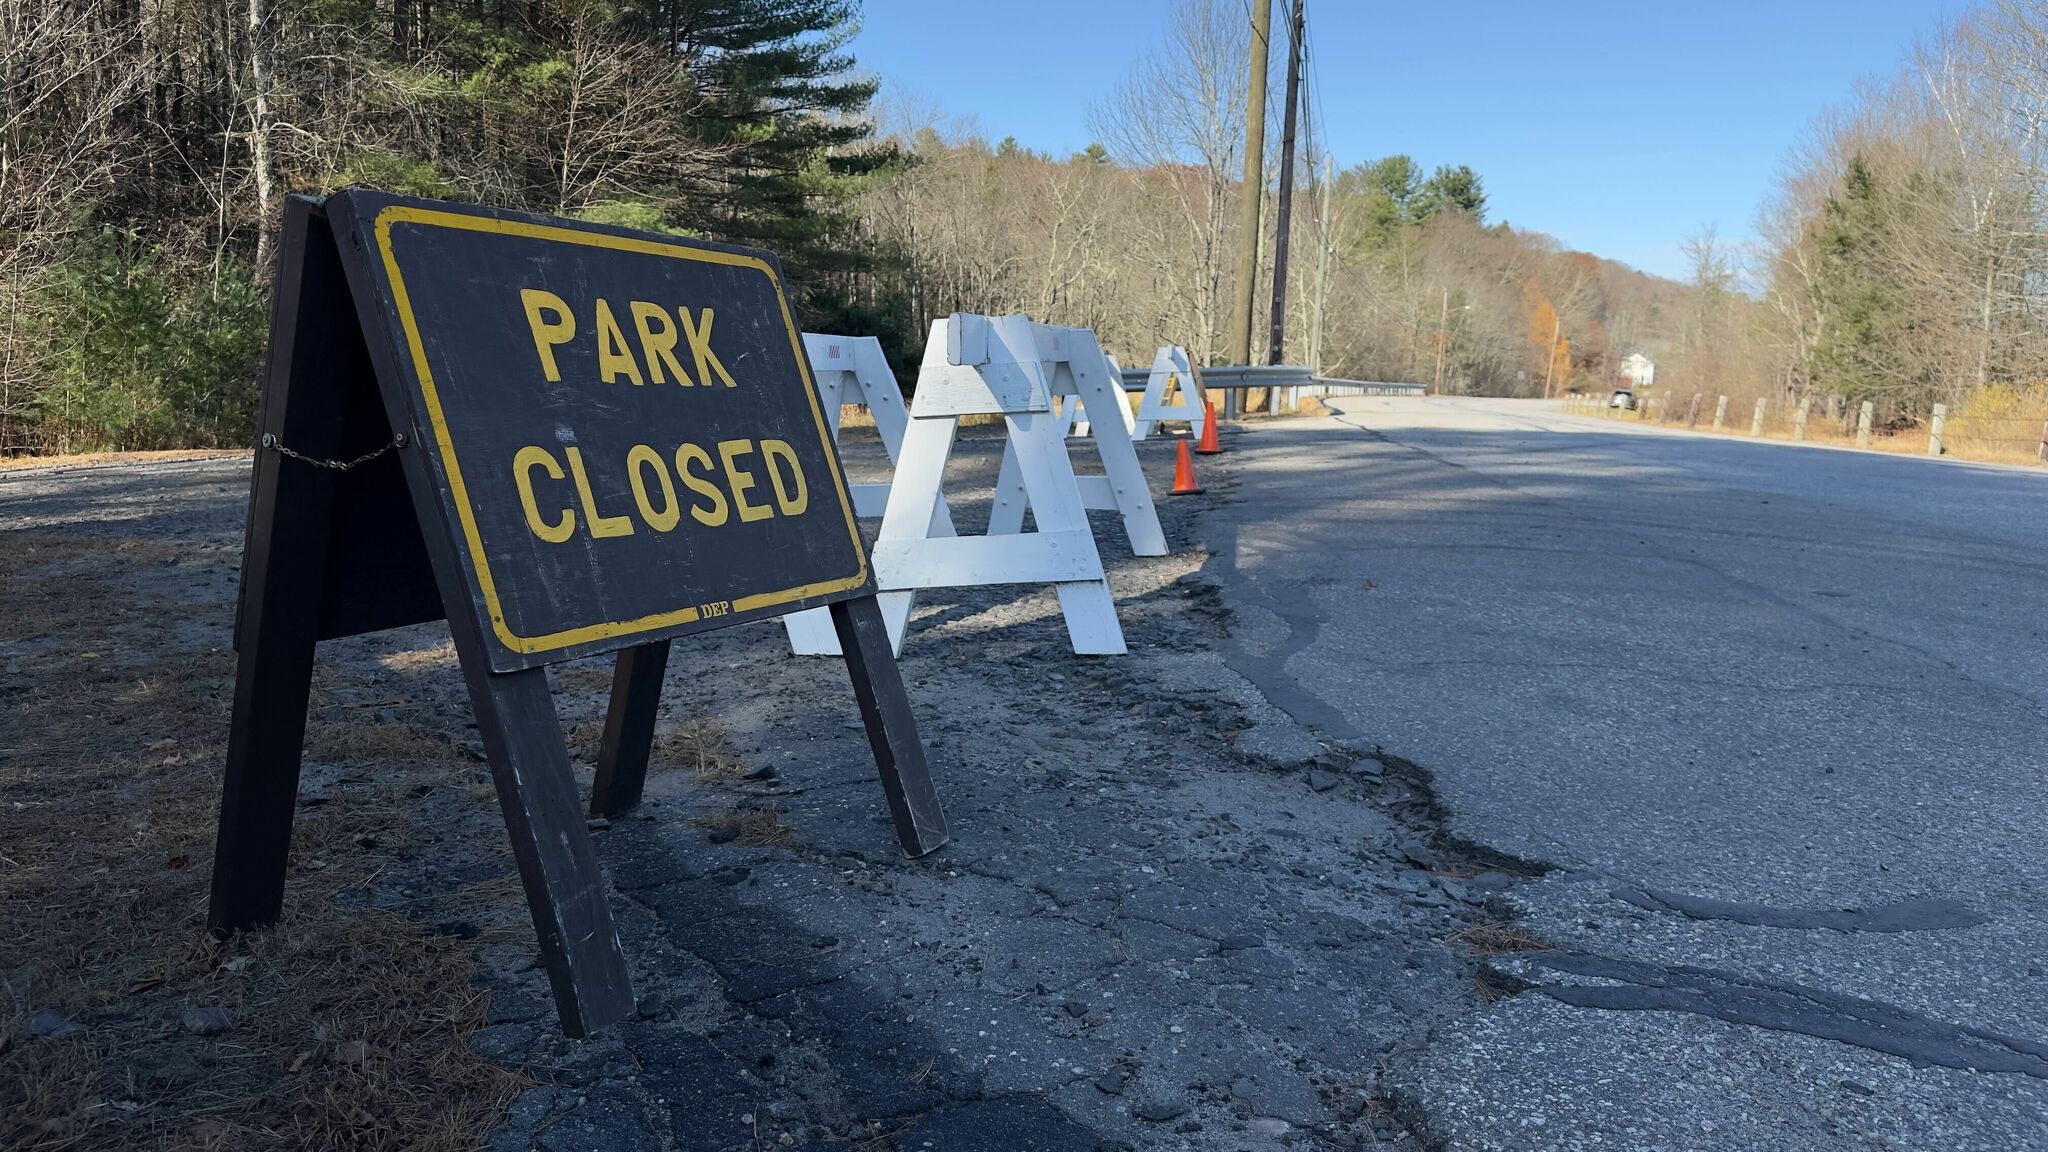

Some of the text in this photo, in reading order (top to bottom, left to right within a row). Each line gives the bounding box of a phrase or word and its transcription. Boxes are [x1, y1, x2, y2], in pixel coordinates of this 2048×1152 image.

[520, 288, 737, 387] PARK
[513, 439, 808, 543] CLOSED
[700, 600, 729, 619] DEP
